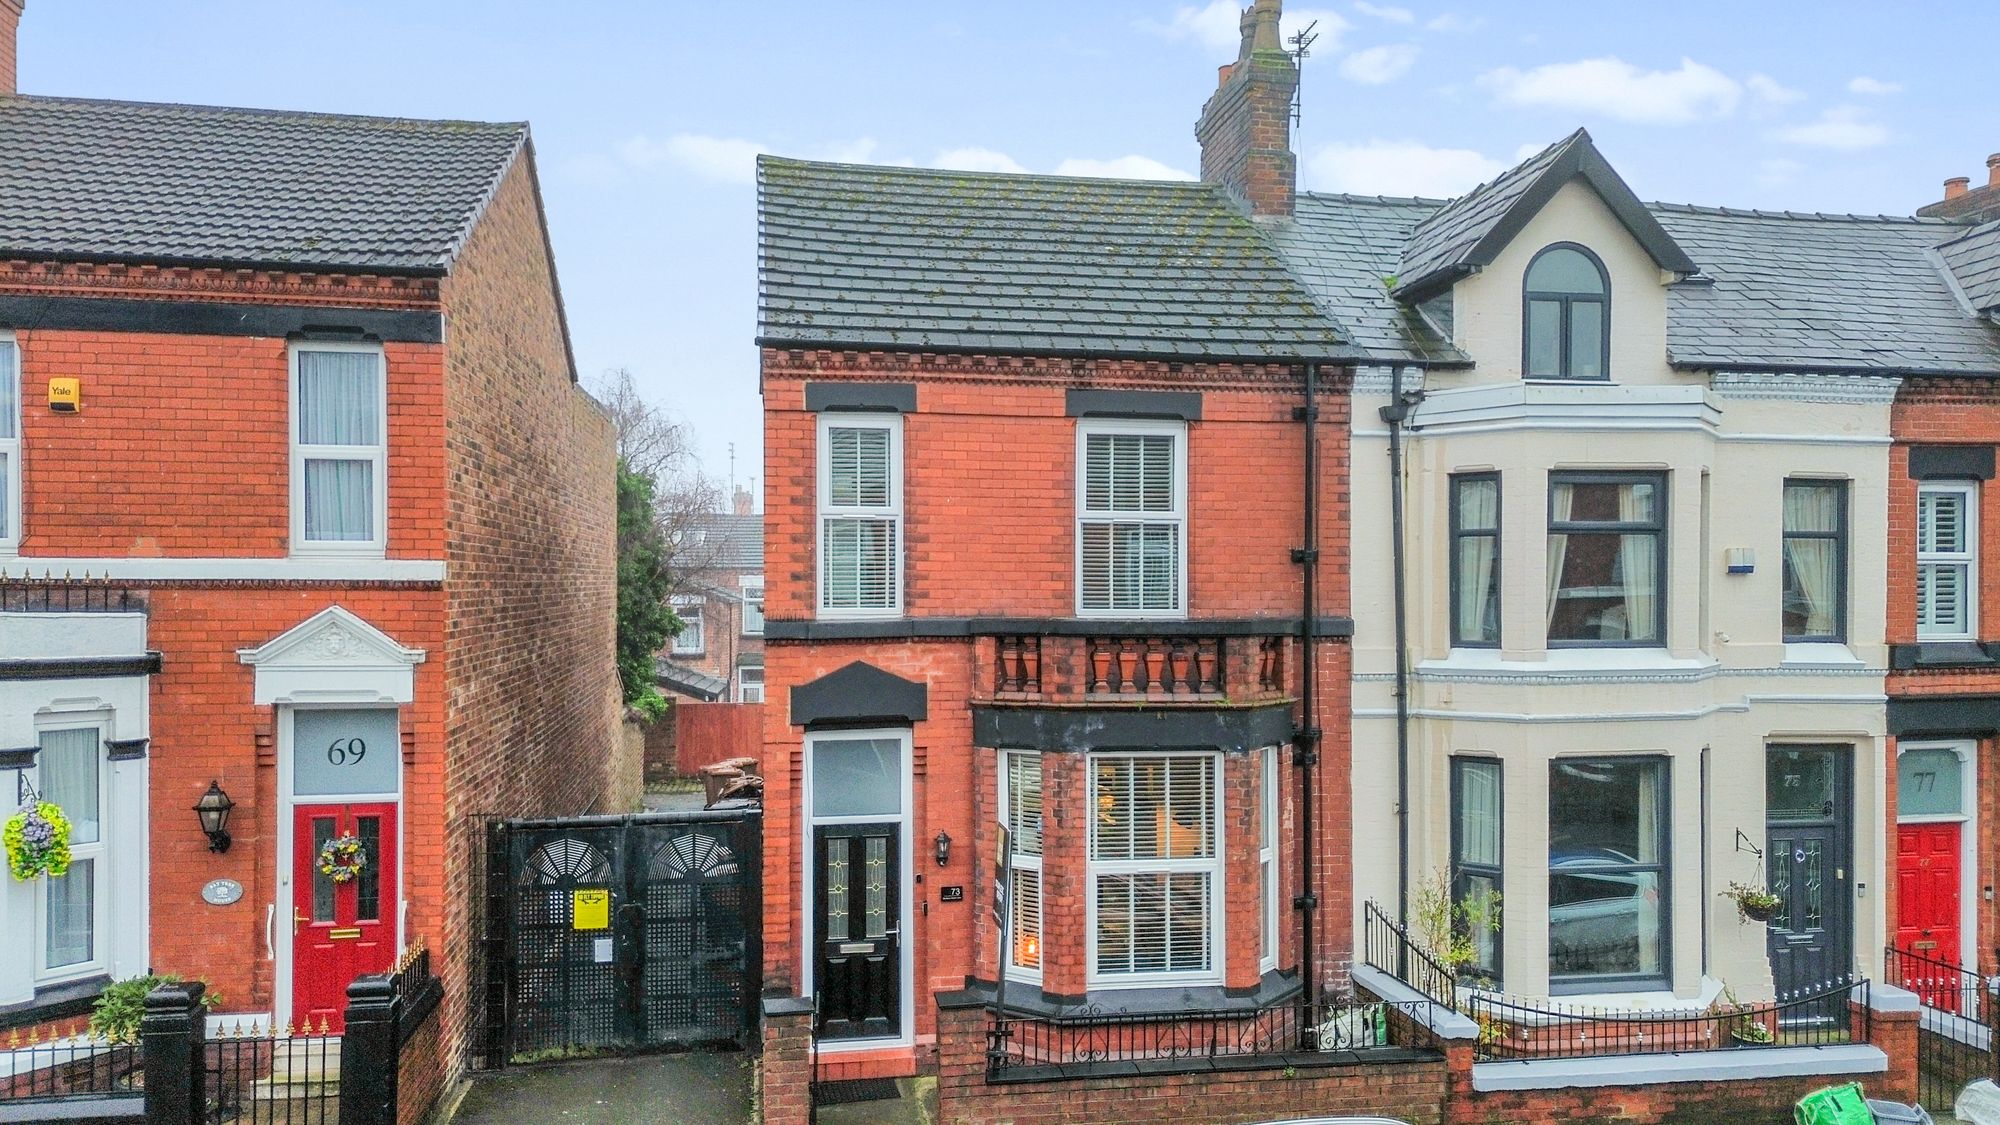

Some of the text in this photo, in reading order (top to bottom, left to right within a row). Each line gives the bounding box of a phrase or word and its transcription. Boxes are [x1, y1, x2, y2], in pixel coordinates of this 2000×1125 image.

[52, 386, 72, 396] Yale
[327, 737, 366, 766] 69
[1913, 771, 1937, 793] 77
[950, 887, 961, 896] 73
